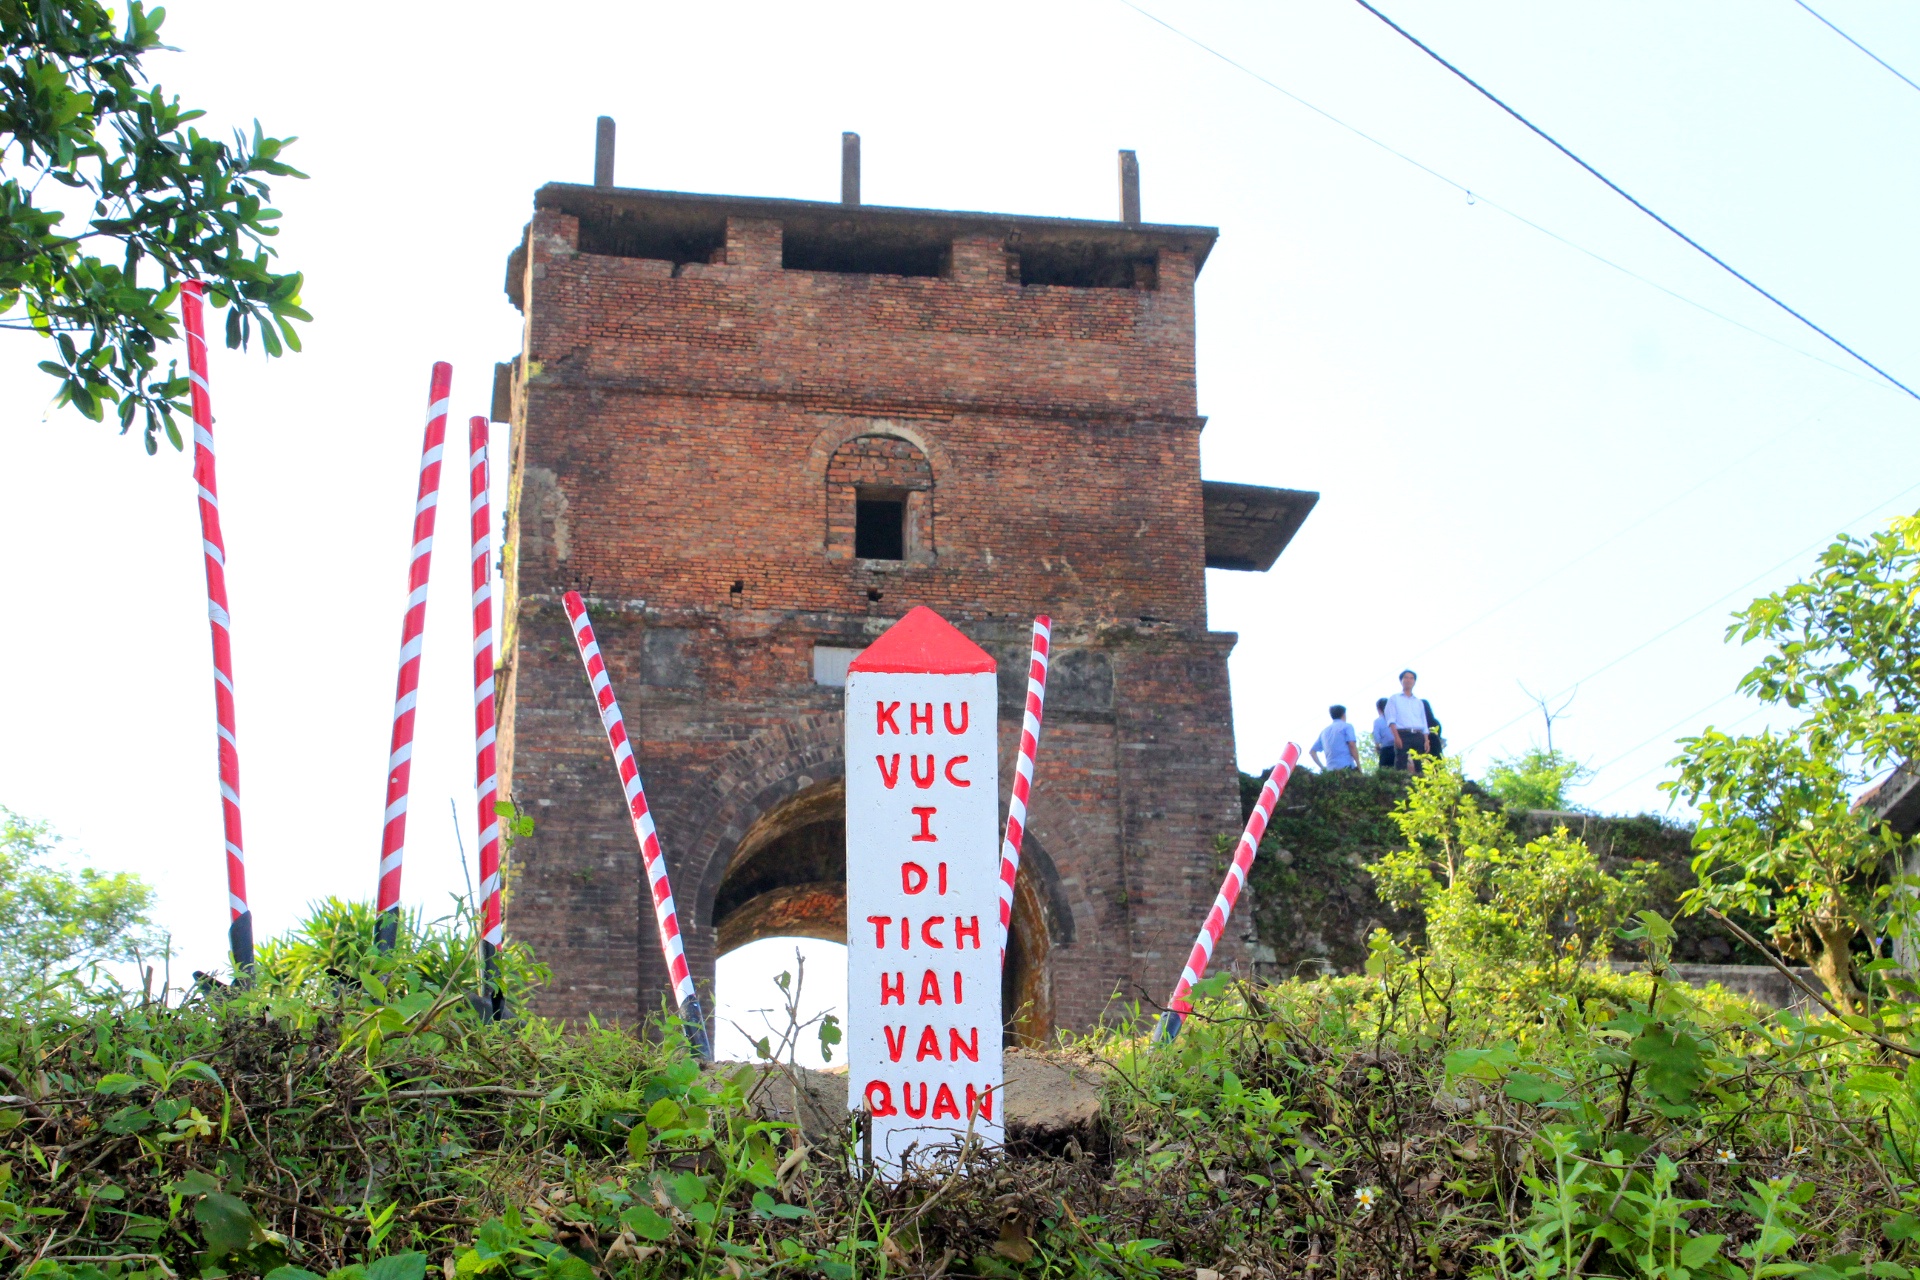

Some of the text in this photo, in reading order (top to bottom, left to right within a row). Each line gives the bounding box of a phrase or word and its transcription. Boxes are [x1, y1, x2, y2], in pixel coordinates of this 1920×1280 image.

[876, 701, 969, 736] KHU
[876, 753, 971, 789] VUC
[911, 806, 938, 842] I
[901, 861, 948, 896] DI
[866, 915, 981, 950] TICH
[880, 968, 964, 1006] HAI
[883, 1024, 980, 1063] VAN
[864, 1079, 994, 1121] QUAN
